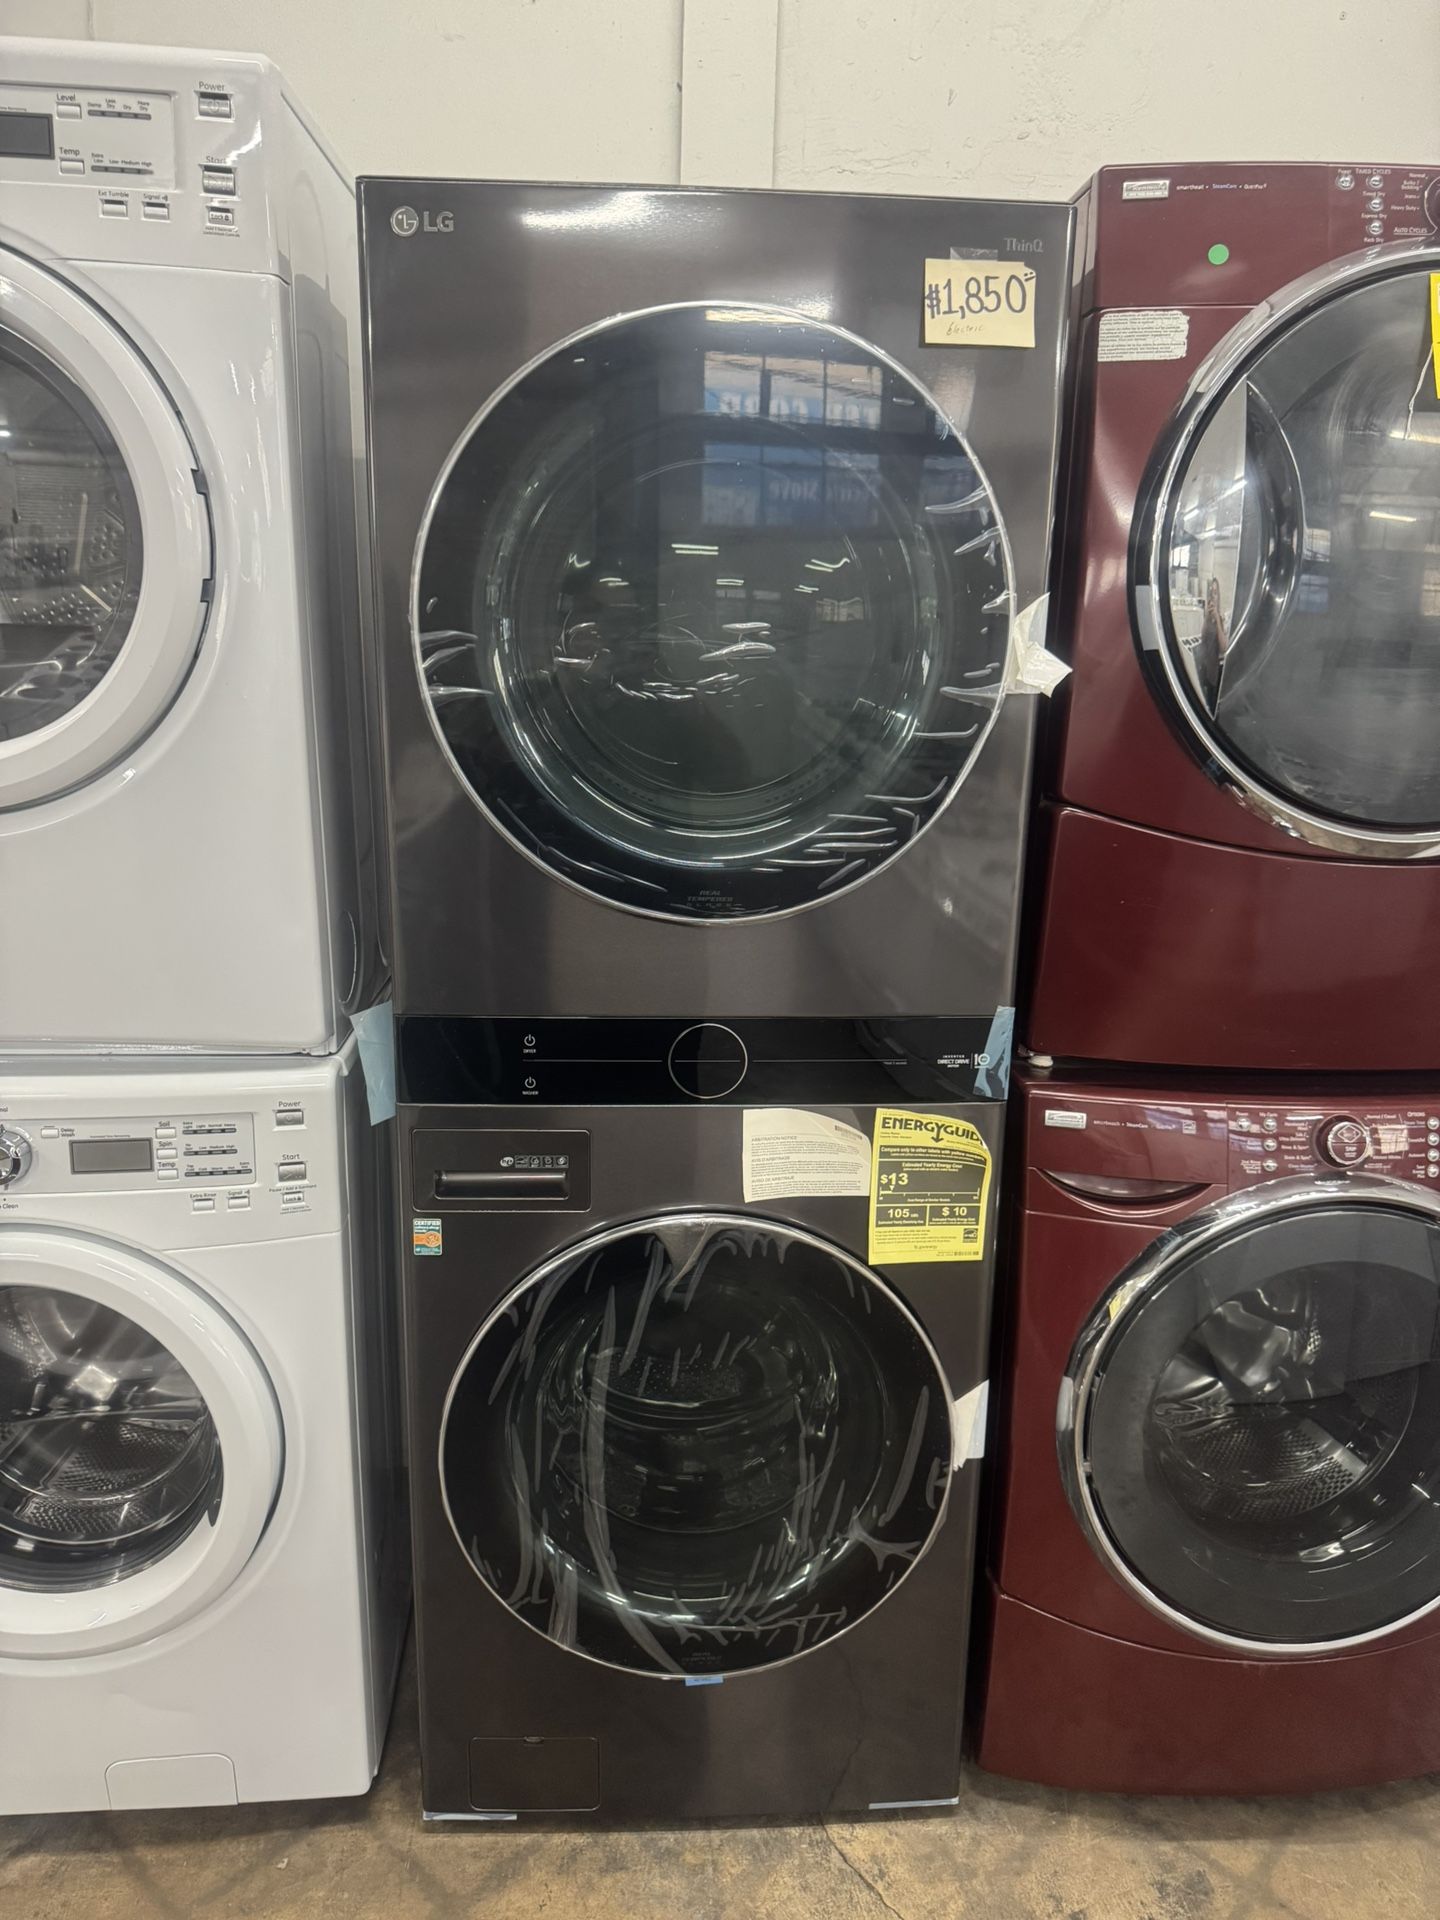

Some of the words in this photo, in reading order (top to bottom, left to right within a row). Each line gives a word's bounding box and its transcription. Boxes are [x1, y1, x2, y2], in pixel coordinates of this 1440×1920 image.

[199, 81, 225, 91] Power
[56, 93, 76, 101] Level
[59, 147, 80, 157] Temp
[423, 210, 454, 232] LG
[1003, 237, 1044, 253] ThinQ
[881, 1116, 983, 1143] ENERGYGUID
[282, 1153, 300, 1161] Start
[880, 1172, 908, 1185] $13
[887, 1208, 910, 1218] 105
[941, 1206, 950, 1216] $
[953, 1206, 967, 1216] 10
